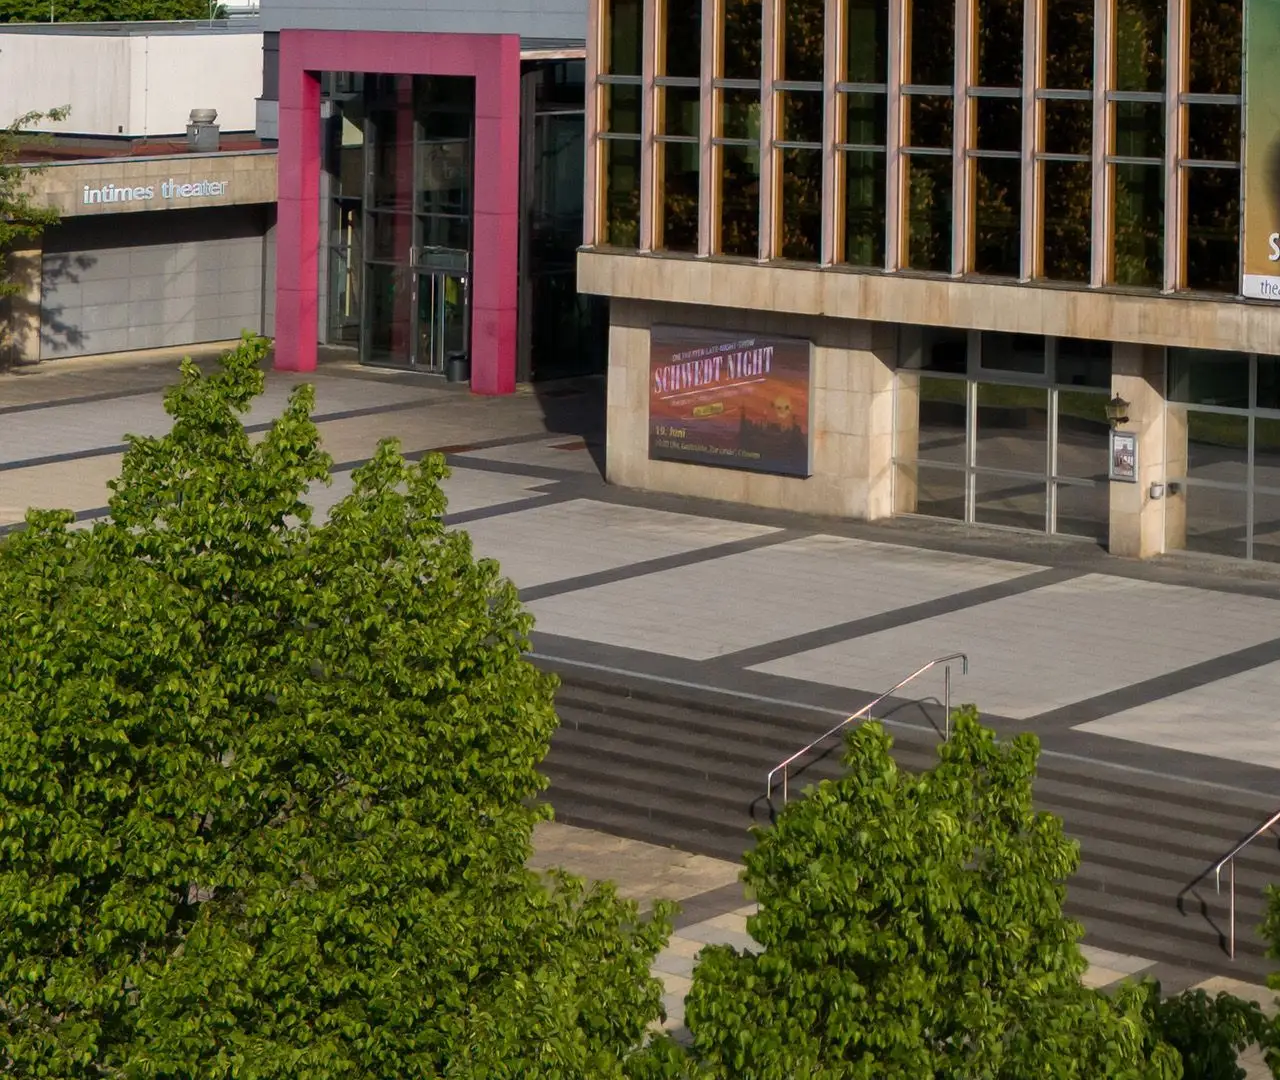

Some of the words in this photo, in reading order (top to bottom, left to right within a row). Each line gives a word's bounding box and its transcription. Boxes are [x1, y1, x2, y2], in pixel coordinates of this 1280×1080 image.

[82, 183, 154, 204] intimes
[161, 178, 229, 199] theater
[654, 355, 723, 394] SCHWEDT
[726, 346, 774, 381] NIGHT
